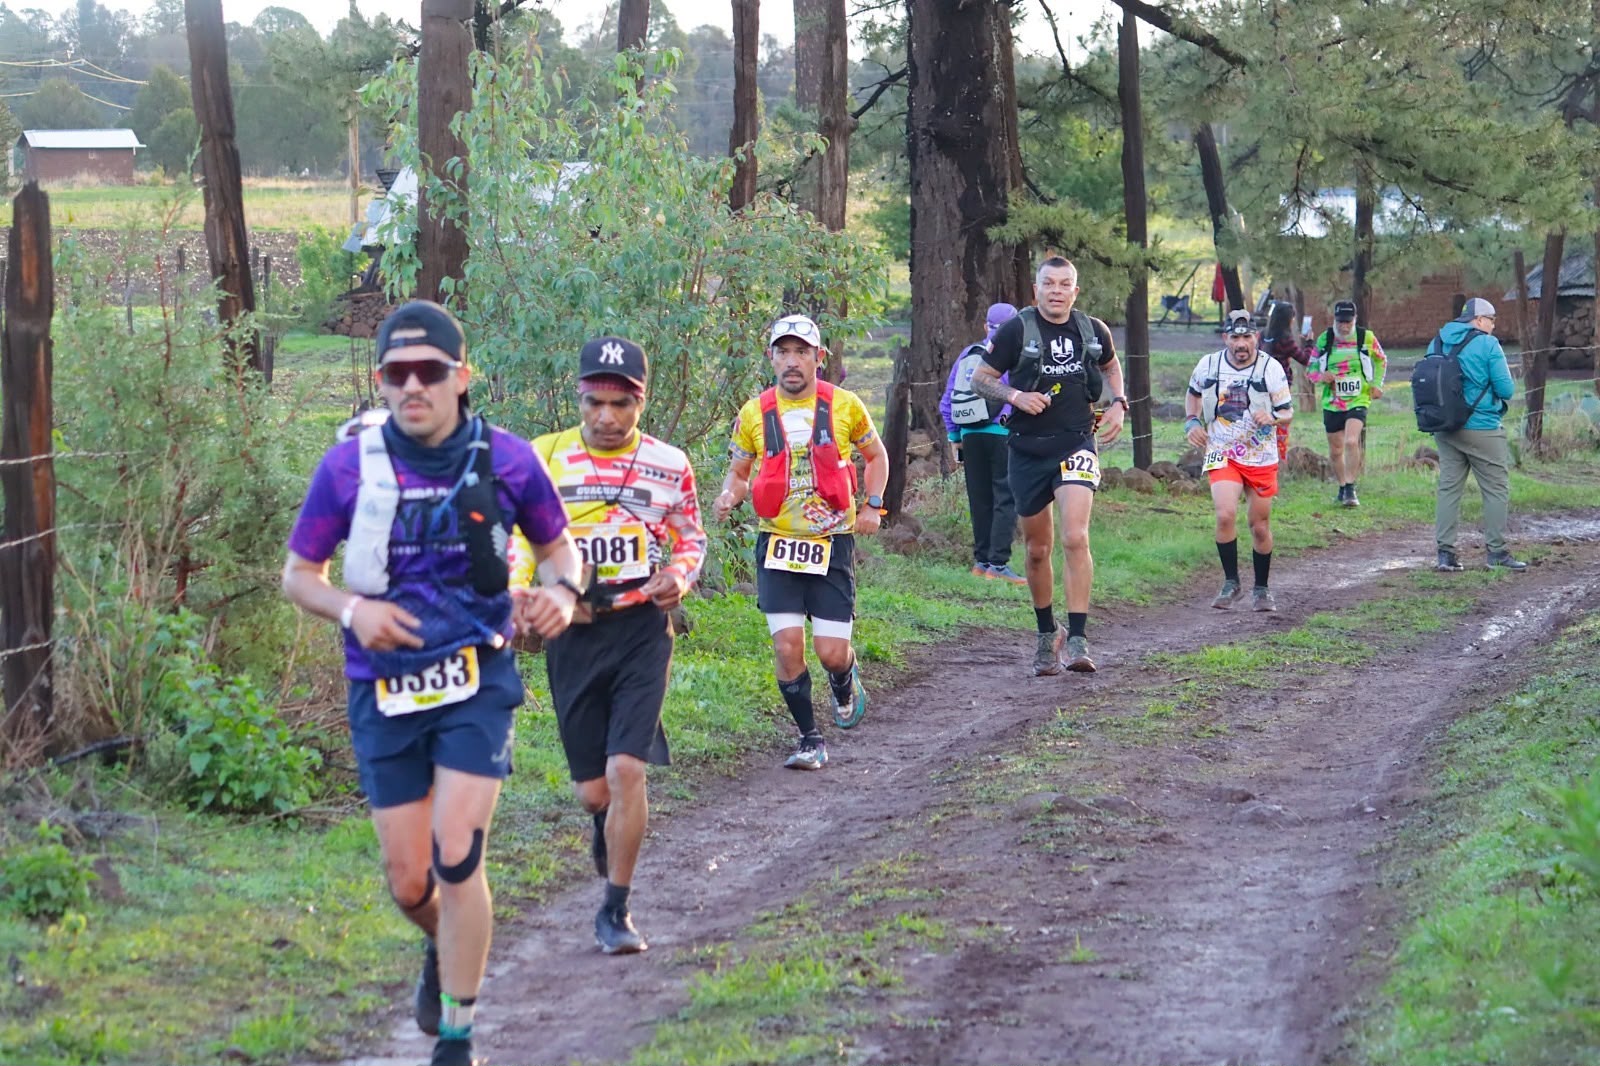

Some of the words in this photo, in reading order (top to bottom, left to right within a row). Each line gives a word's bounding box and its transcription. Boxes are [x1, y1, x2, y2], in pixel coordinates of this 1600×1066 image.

[600, 341, 625, 366] NY
[1337, 380, 1360, 392] 1064
[952, 408, 976, 418] NASA
[574, 535, 640, 564] 6081
[772, 538, 825, 565] 6198
